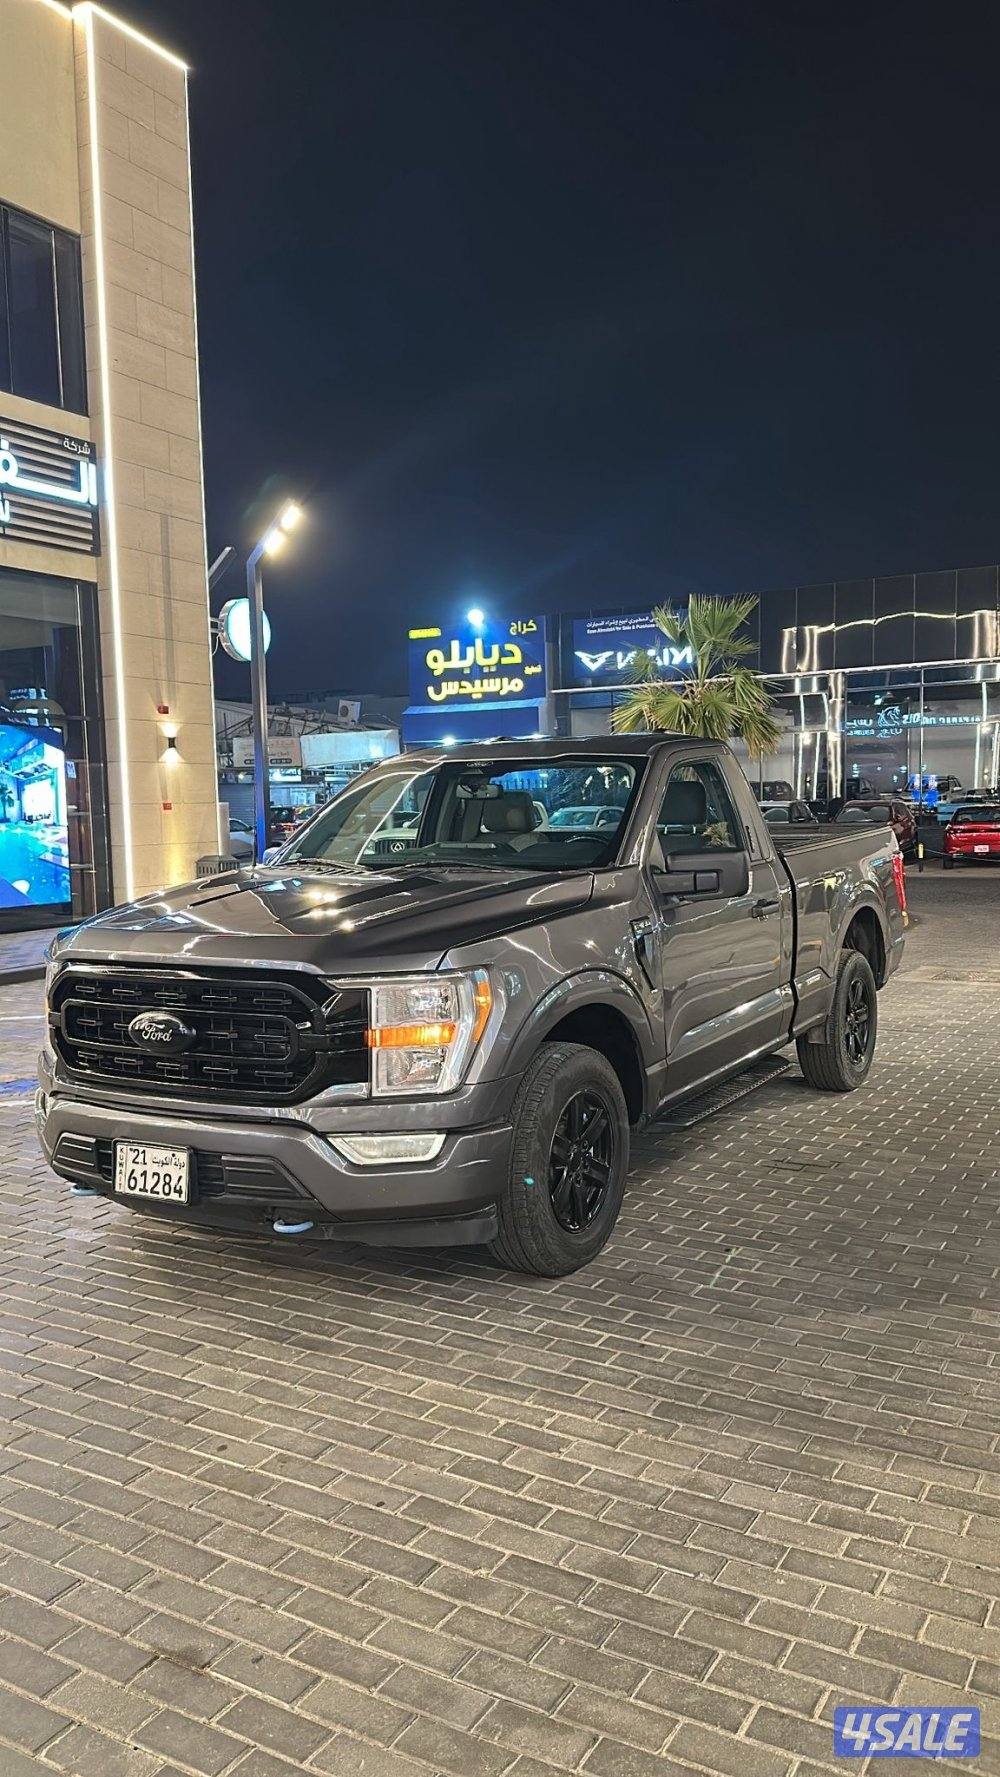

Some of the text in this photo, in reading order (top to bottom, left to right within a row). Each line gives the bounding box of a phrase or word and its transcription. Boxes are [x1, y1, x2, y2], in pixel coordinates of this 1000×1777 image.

[63, 438, 91, 454] شركة
[510, 620, 537, 636] كراج
[426, 638, 523, 676] ديابلو
[427, 677, 524, 701] مرسيدس
[142, 1021, 173, 1042] Ford
[131, 1148, 147, 1166] 21
[152, 1156, 186, 1170] دولة الكويت
[127, 1169, 183, 1198] 61284
